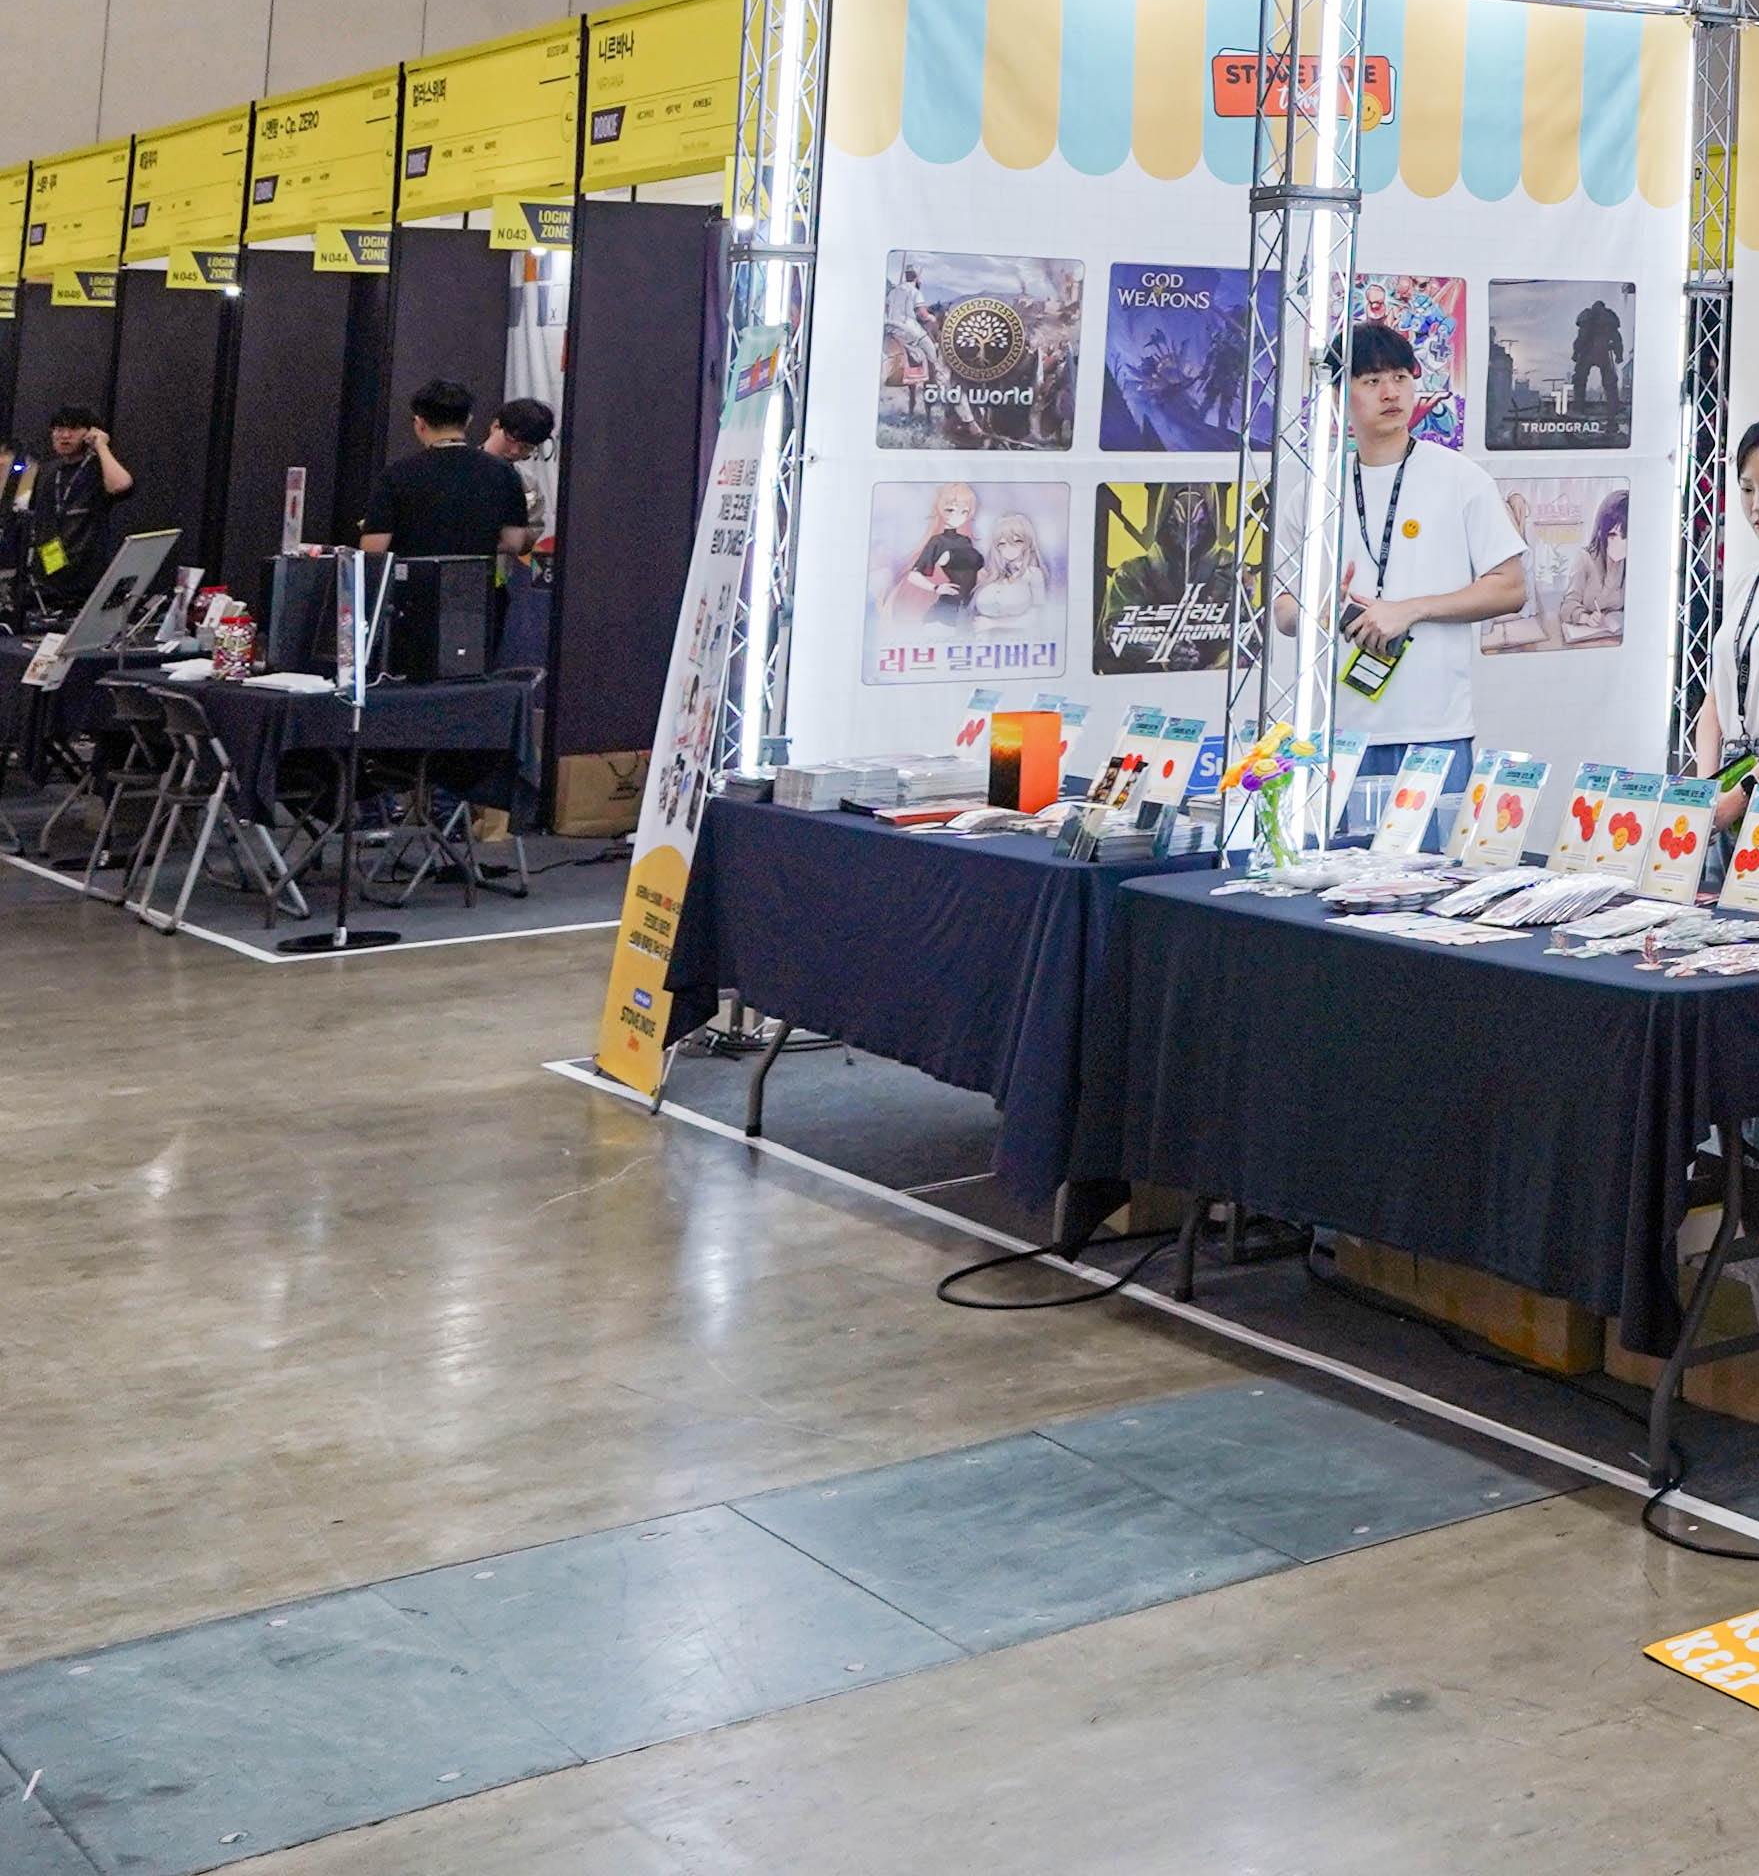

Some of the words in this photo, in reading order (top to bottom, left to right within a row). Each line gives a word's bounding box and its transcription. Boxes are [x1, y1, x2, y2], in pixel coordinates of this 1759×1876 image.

[598, 30, 635, 63] 니르바나
[539, 210, 571, 224] LOGIN
[541, 225, 569, 239] ZONE
[358, 235, 388, 247] LOGIN
[207, 257, 236, 269] LOGIN
[360, 250, 387, 262] ZONE
[209, 269, 234, 280] ZONE
[1142, 272, 1183, 289] GOD
[1118, 289, 1210, 309] WEAPONS
[968, 385, 1034, 405] world
[1521, 421, 1600, 434] TRUDOGRAD
[879, 645, 937, 674] 러브
[946, 641, 1057, 670] 딜리버리
